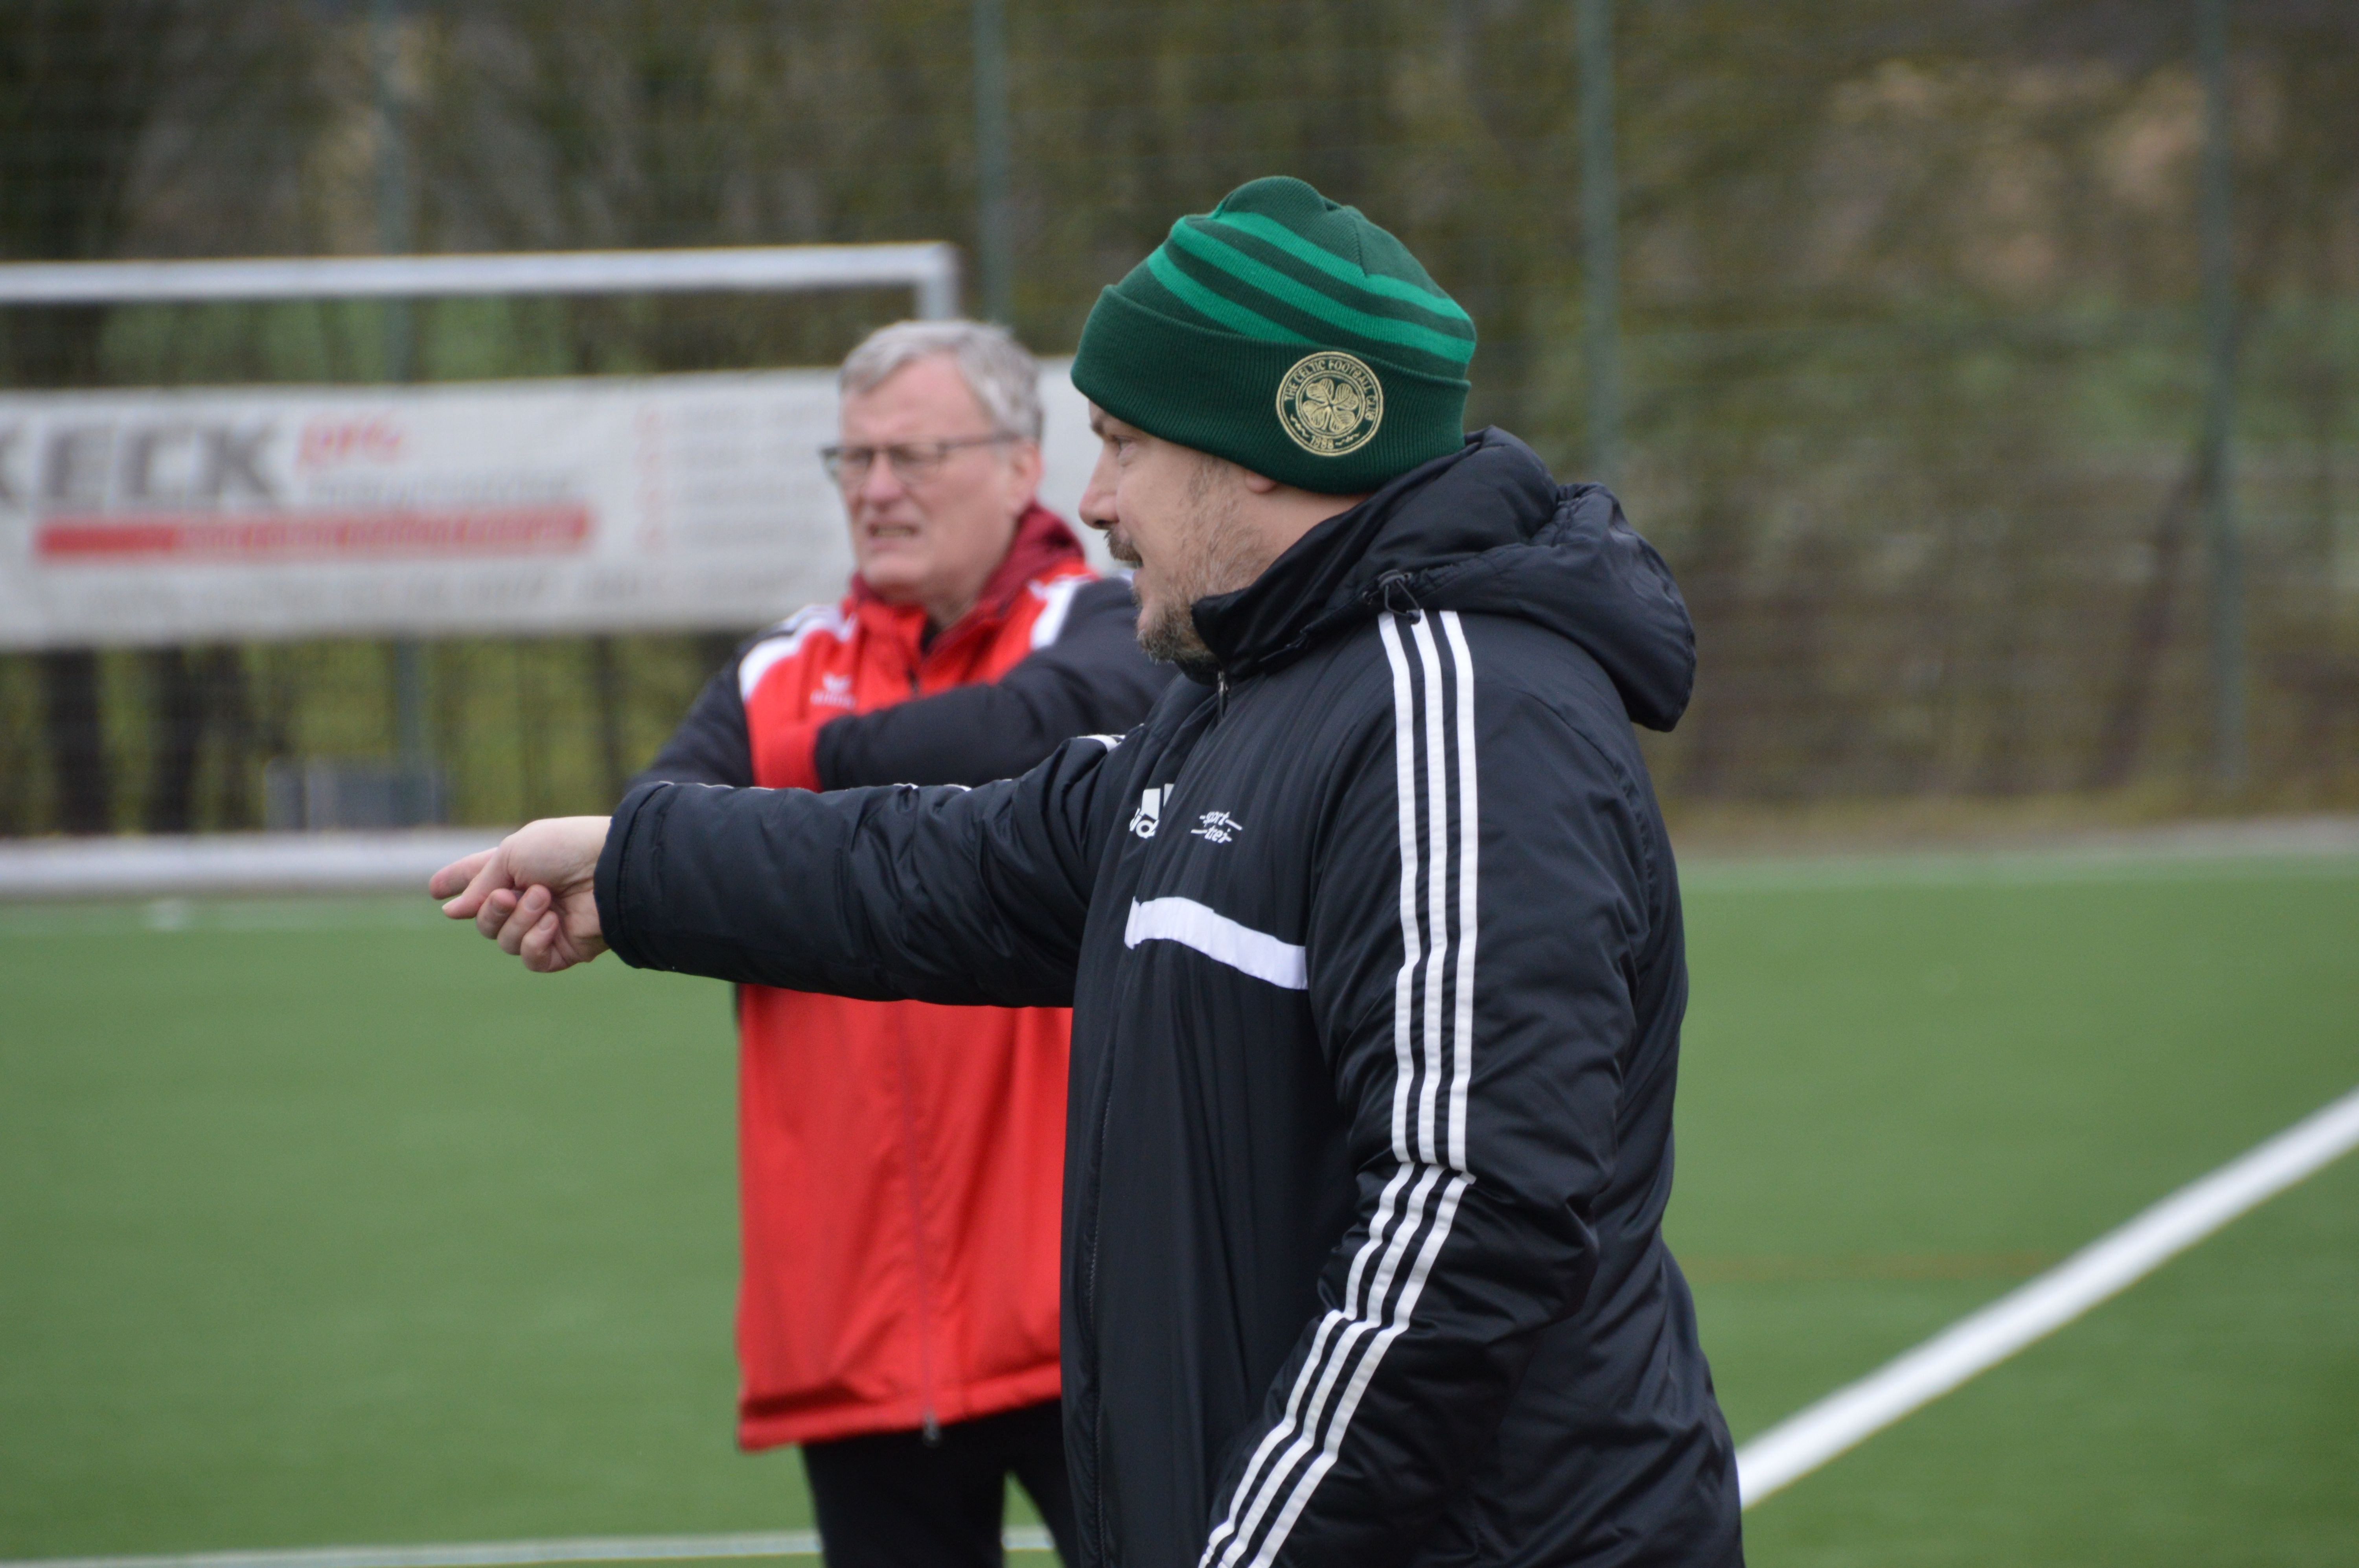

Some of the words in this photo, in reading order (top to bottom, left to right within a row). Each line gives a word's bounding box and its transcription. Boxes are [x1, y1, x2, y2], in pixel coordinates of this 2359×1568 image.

[1284, 383, 1299, 401] THE
[1294, 360, 1326, 382] CELTIC
[1329, 359, 1372, 393] FOOTBALL
[1365, 395, 1377, 421] CLUB
[1309, 436, 1334, 449] 1888
